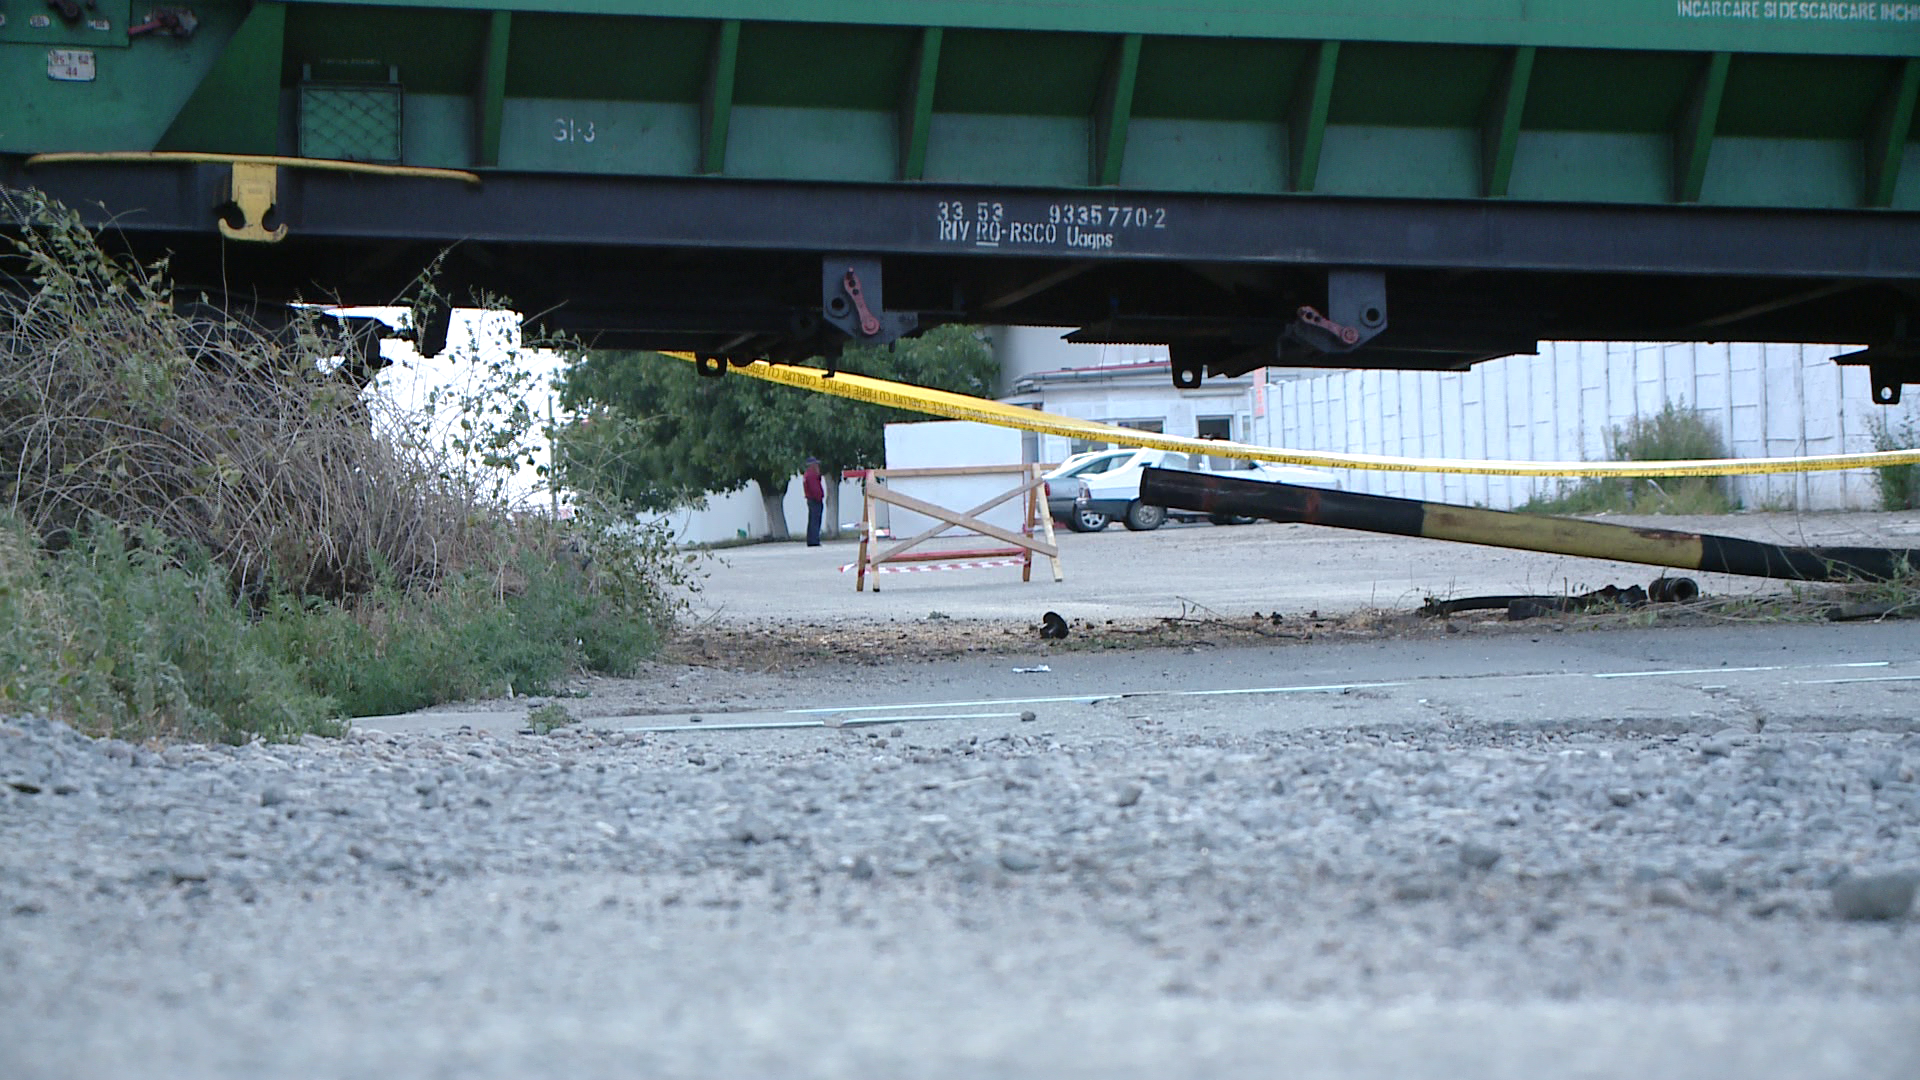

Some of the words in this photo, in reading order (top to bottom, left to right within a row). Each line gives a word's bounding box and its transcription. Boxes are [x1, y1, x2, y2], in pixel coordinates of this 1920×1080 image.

[1677, 0, 1759, 18] INCARCARE
[937, 201, 964, 221] 33
[977, 202, 1004, 222] 53
[939, 220, 970, 241] RIV
[1066, 226, 1114, 250] Uagps
[782, 367, 817, 387] CABLURI
